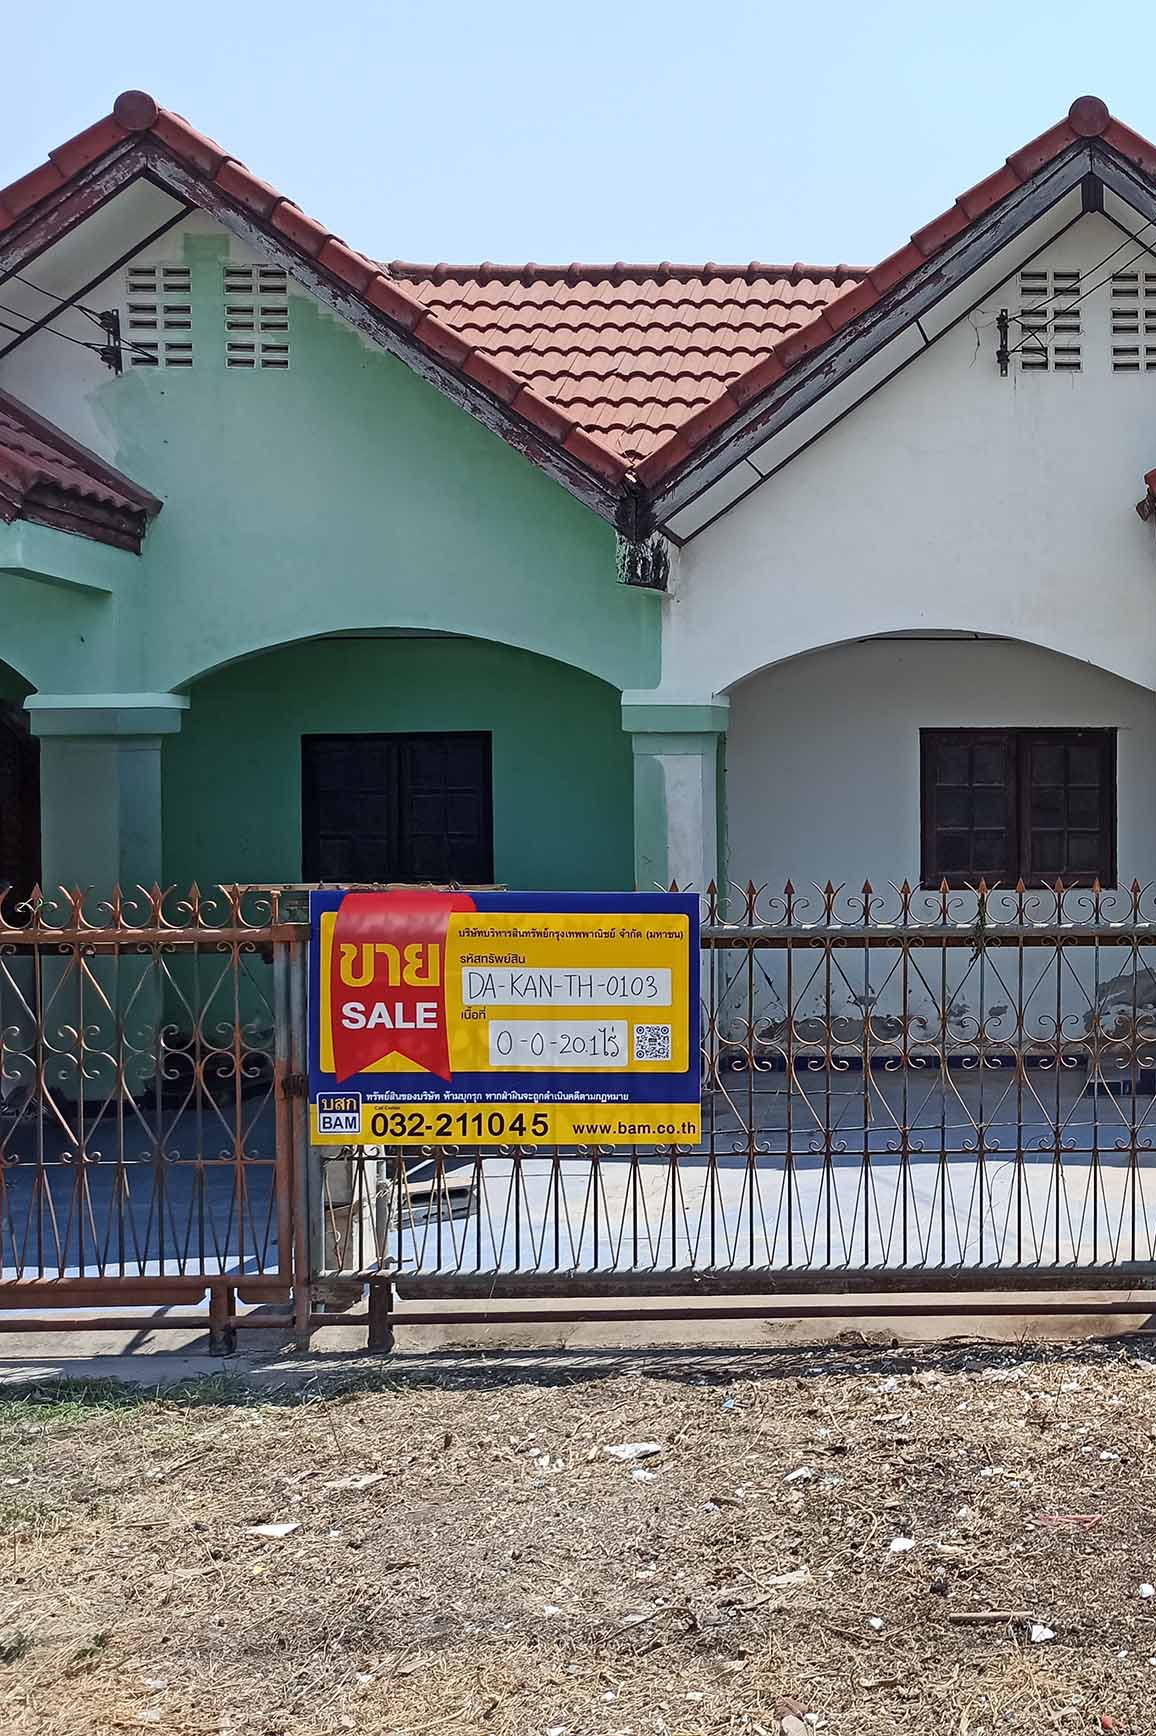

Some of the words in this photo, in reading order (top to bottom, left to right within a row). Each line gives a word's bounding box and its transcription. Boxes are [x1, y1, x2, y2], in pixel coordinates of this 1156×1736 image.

[619, 927, 642, 939] จำกัด
[646, 930, 684, 940] (มหาชน)
[339, 942, 440, 988] ขาย
[459, 952, 526, 964] รหัสทรัพย์สิน
[468, 971, 659, 1000] DA-KAN-TH-0103
[341, 1001, 438, 1030] SALE
[460, 1006, 487, 1020] เนื้อที่
[321, 1097, 358, 1111] บสก
[322, 1116, 357, 1130] BAM
[371, 1112, 549, 1137] 032-211045
[572, 1121, 697, 1135] www.bam.co.th
